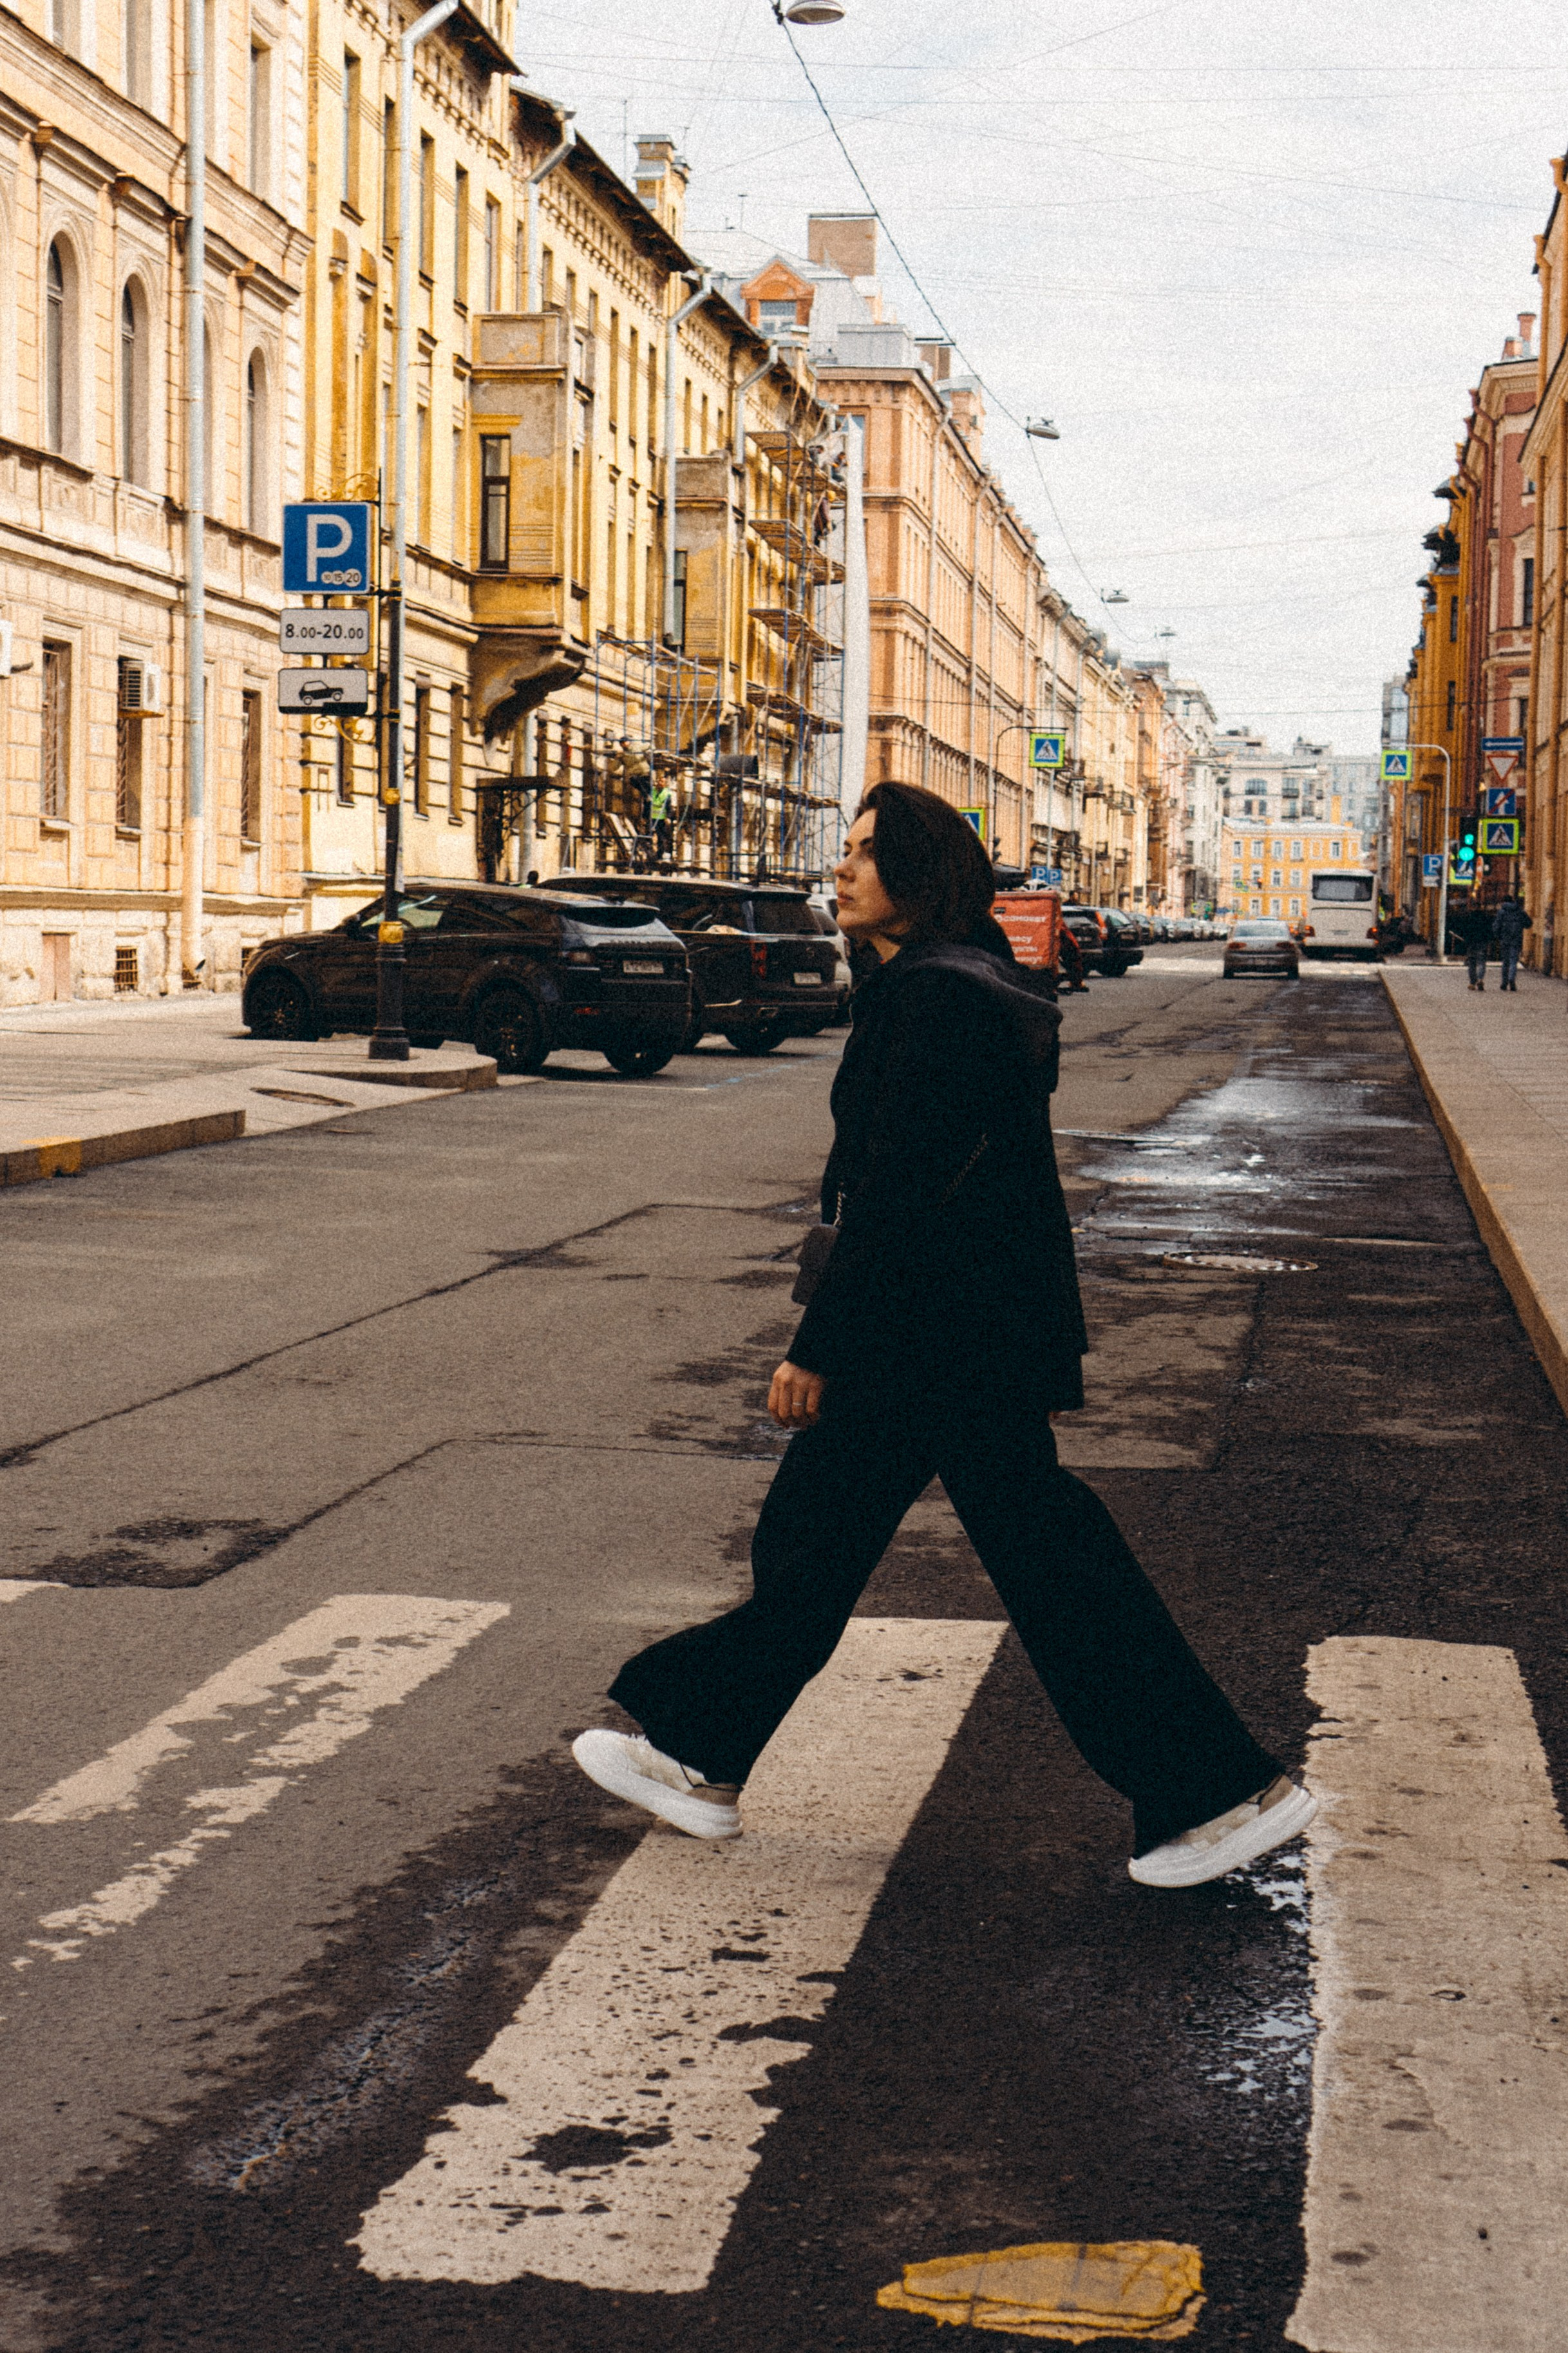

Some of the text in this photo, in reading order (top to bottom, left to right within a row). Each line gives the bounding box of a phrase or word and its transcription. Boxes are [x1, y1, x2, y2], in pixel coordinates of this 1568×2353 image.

[307, 514, 353, 582] P
[346, 572, 360, 582] 20
[285, 624, 364, 639] 8.00-20.00
[1429, 857, 1442, 873] P
[1036, 868, 1046, 879] P
[1050, 870, 1059, 882] P
